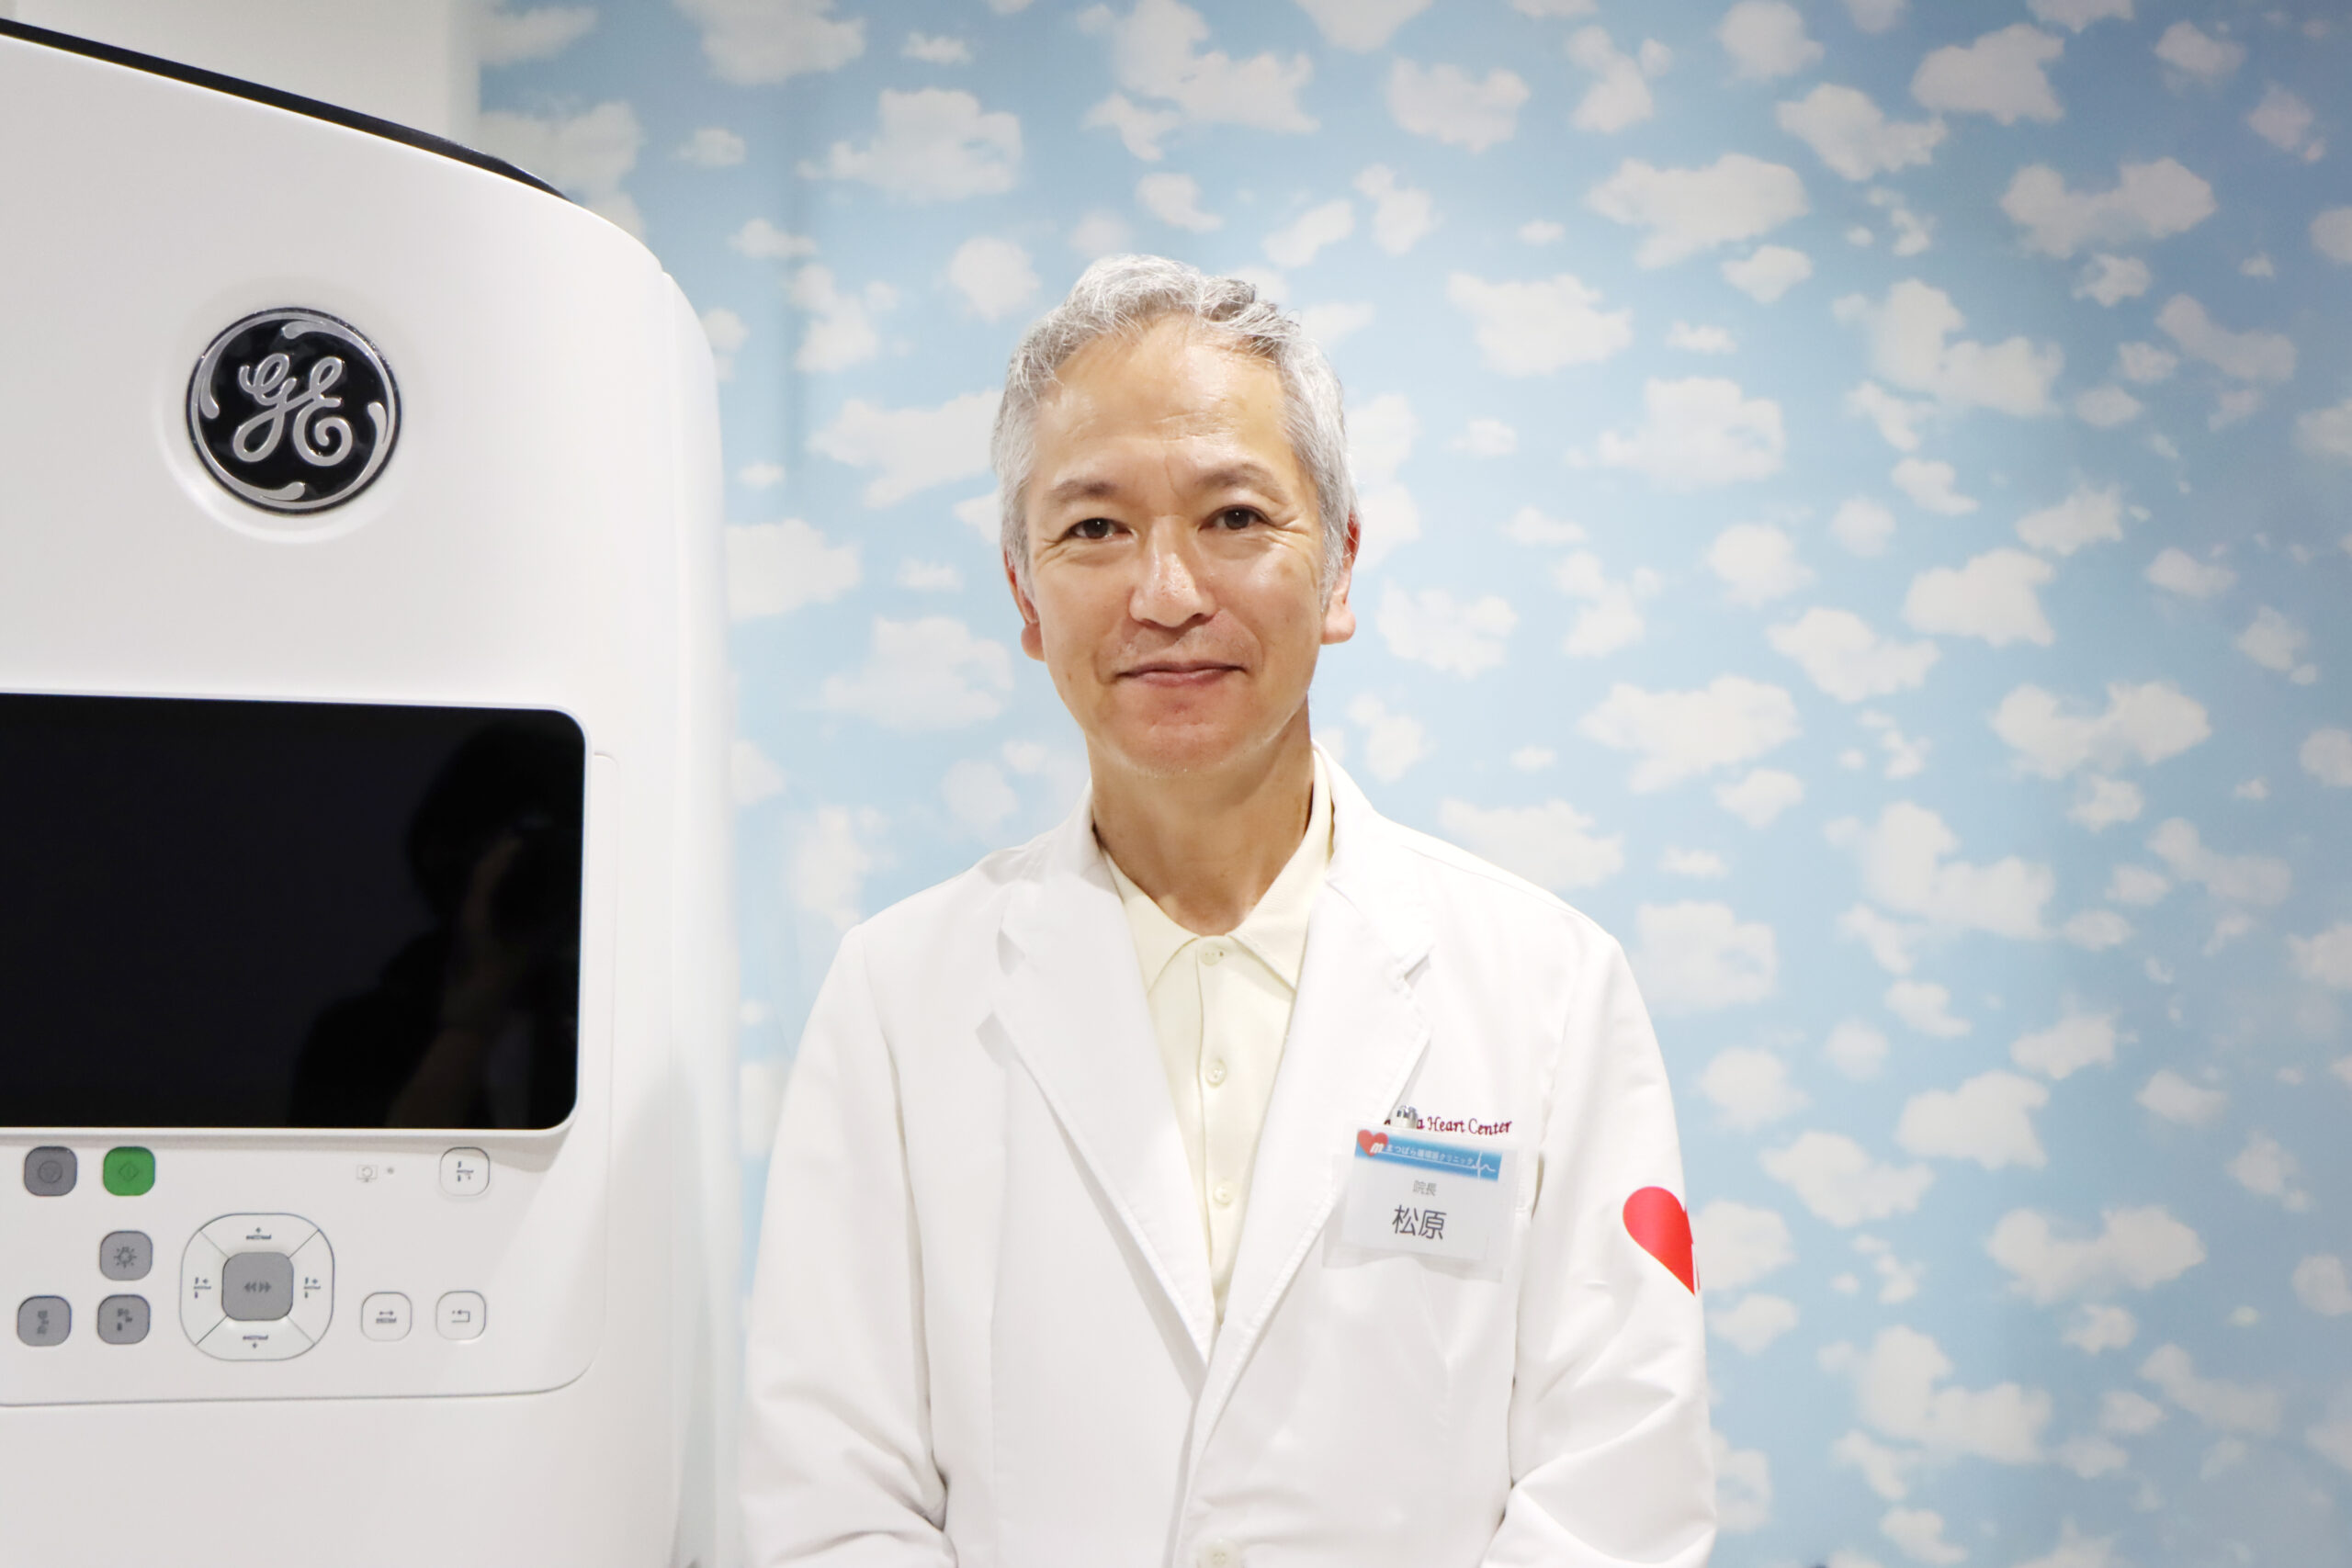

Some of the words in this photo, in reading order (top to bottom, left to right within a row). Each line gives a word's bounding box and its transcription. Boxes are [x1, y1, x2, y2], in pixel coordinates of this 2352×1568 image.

[233, 353, 353, 467] GE
[1427, 1116, 1465, 1134] Heart
[1468, 1118, 1512, 1135] Center
[1412, 1180, 1437, 1196] 院長
[1392, 1204, 1447, 1240] 松原
